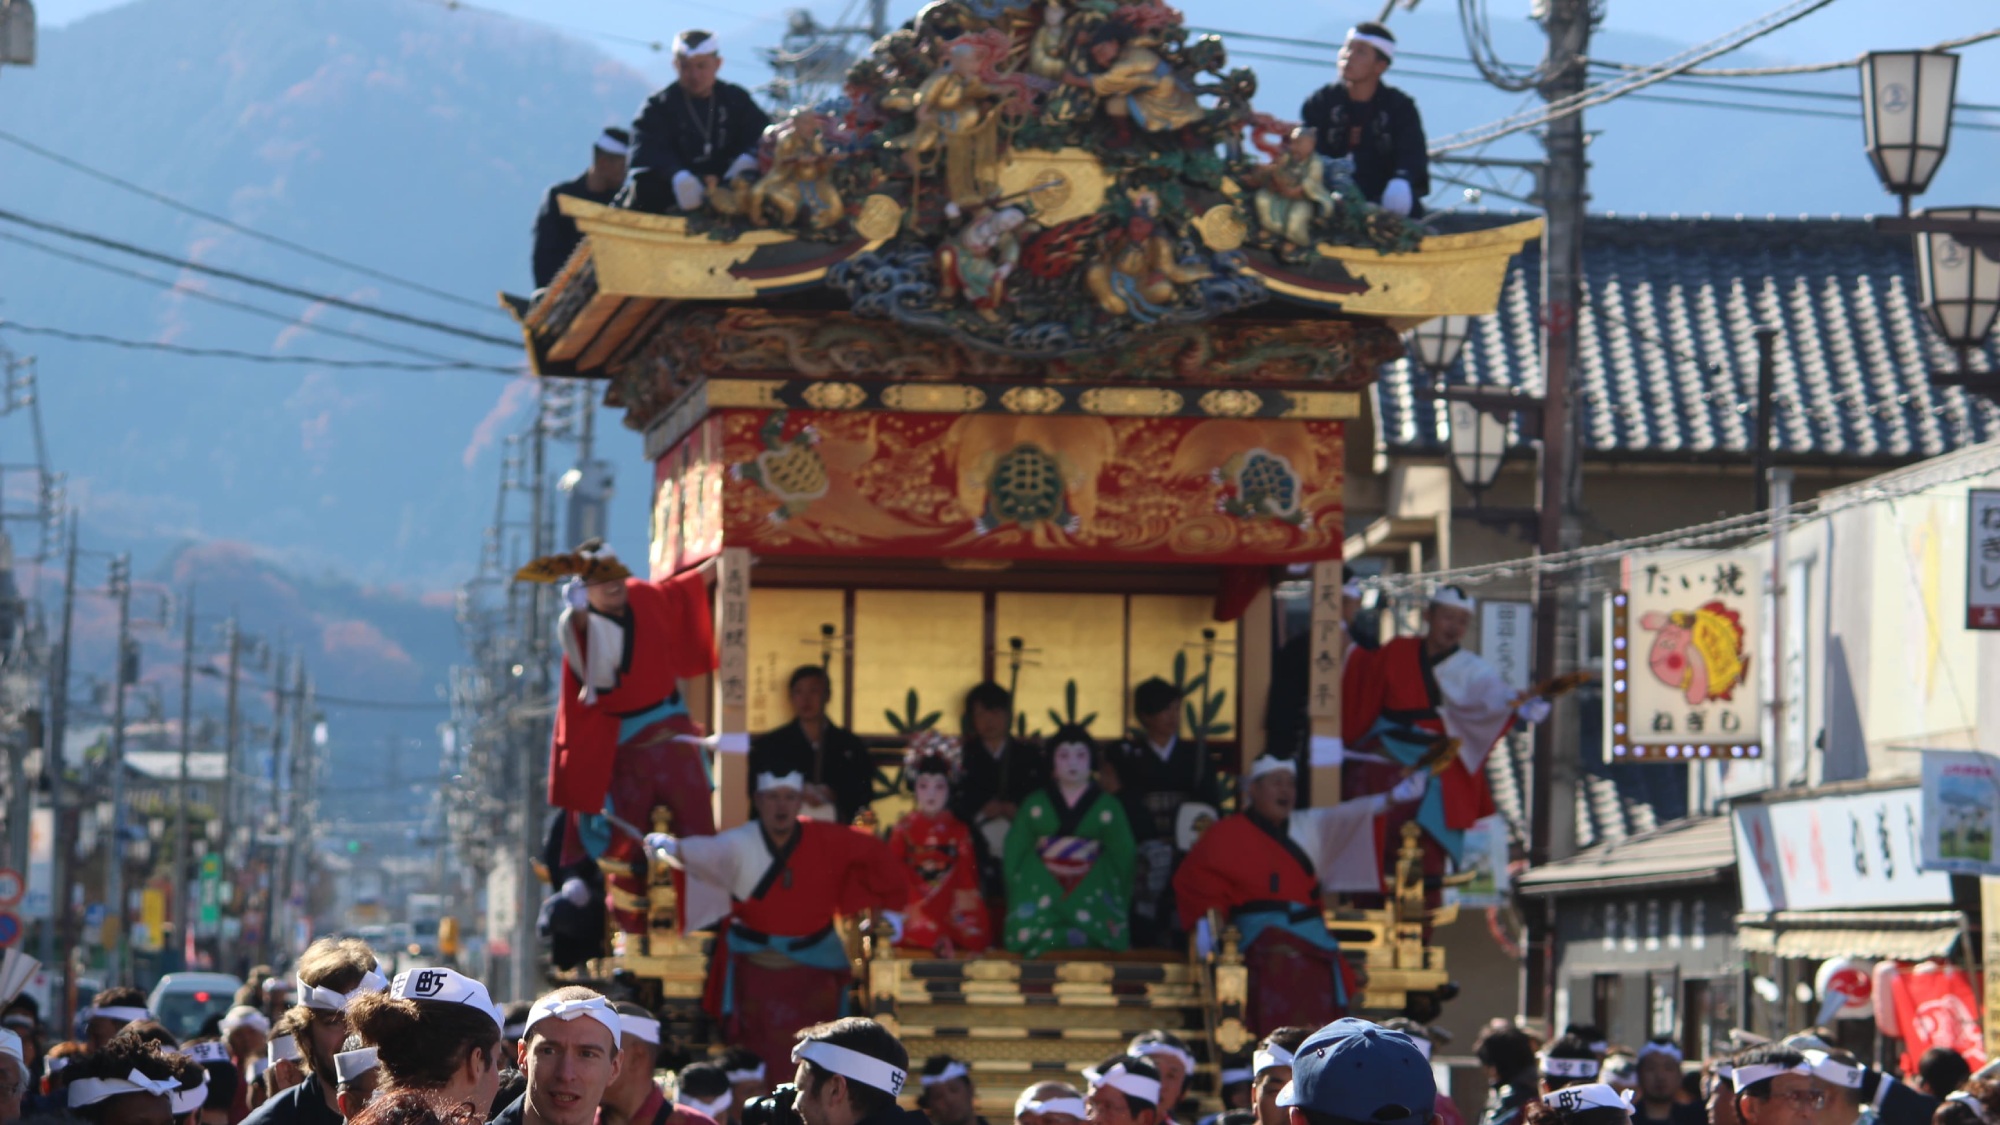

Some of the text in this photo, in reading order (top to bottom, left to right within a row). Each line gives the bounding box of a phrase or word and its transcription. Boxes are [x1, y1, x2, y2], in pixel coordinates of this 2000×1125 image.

[1646, 563, 1744, 595] たい焼
[1652, 710, 1740, 732] ねぎし
